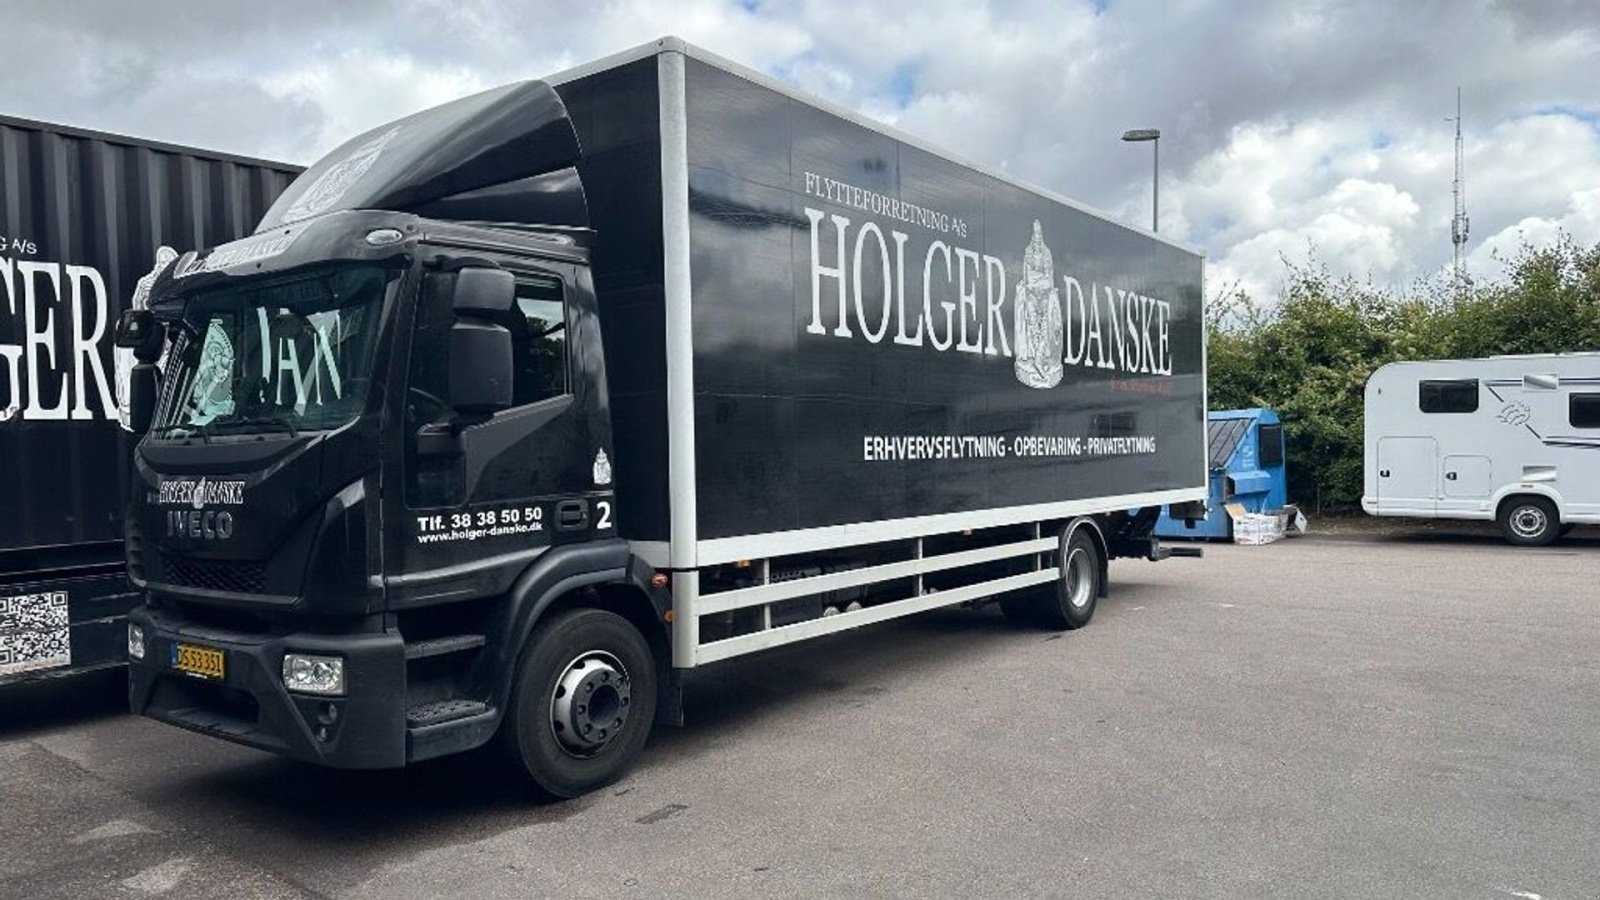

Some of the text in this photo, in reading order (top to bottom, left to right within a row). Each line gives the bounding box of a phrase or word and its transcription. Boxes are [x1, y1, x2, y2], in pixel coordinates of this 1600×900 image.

[804, 171, 967, 238] FLYTTEFORRETNING A/S
[12, 237, 37, 255] A/S
[804, 207, 1173, 376] HOLGER DANSKE
[863, 436, 1005, 460] ERHVERVSFLYTNING
[1014, 437, 1081, 456] OPBEVARING
[1088, 437, 1156, 454] PRIVATFLYTNING
[166, 510, 233, 539] IVECO
[417, 506, 542, 531] Tlf. 38 38 50 50
[596, 501, 612, 529] 2
[417, 521, 543, 543] www.holger-danske.dk
